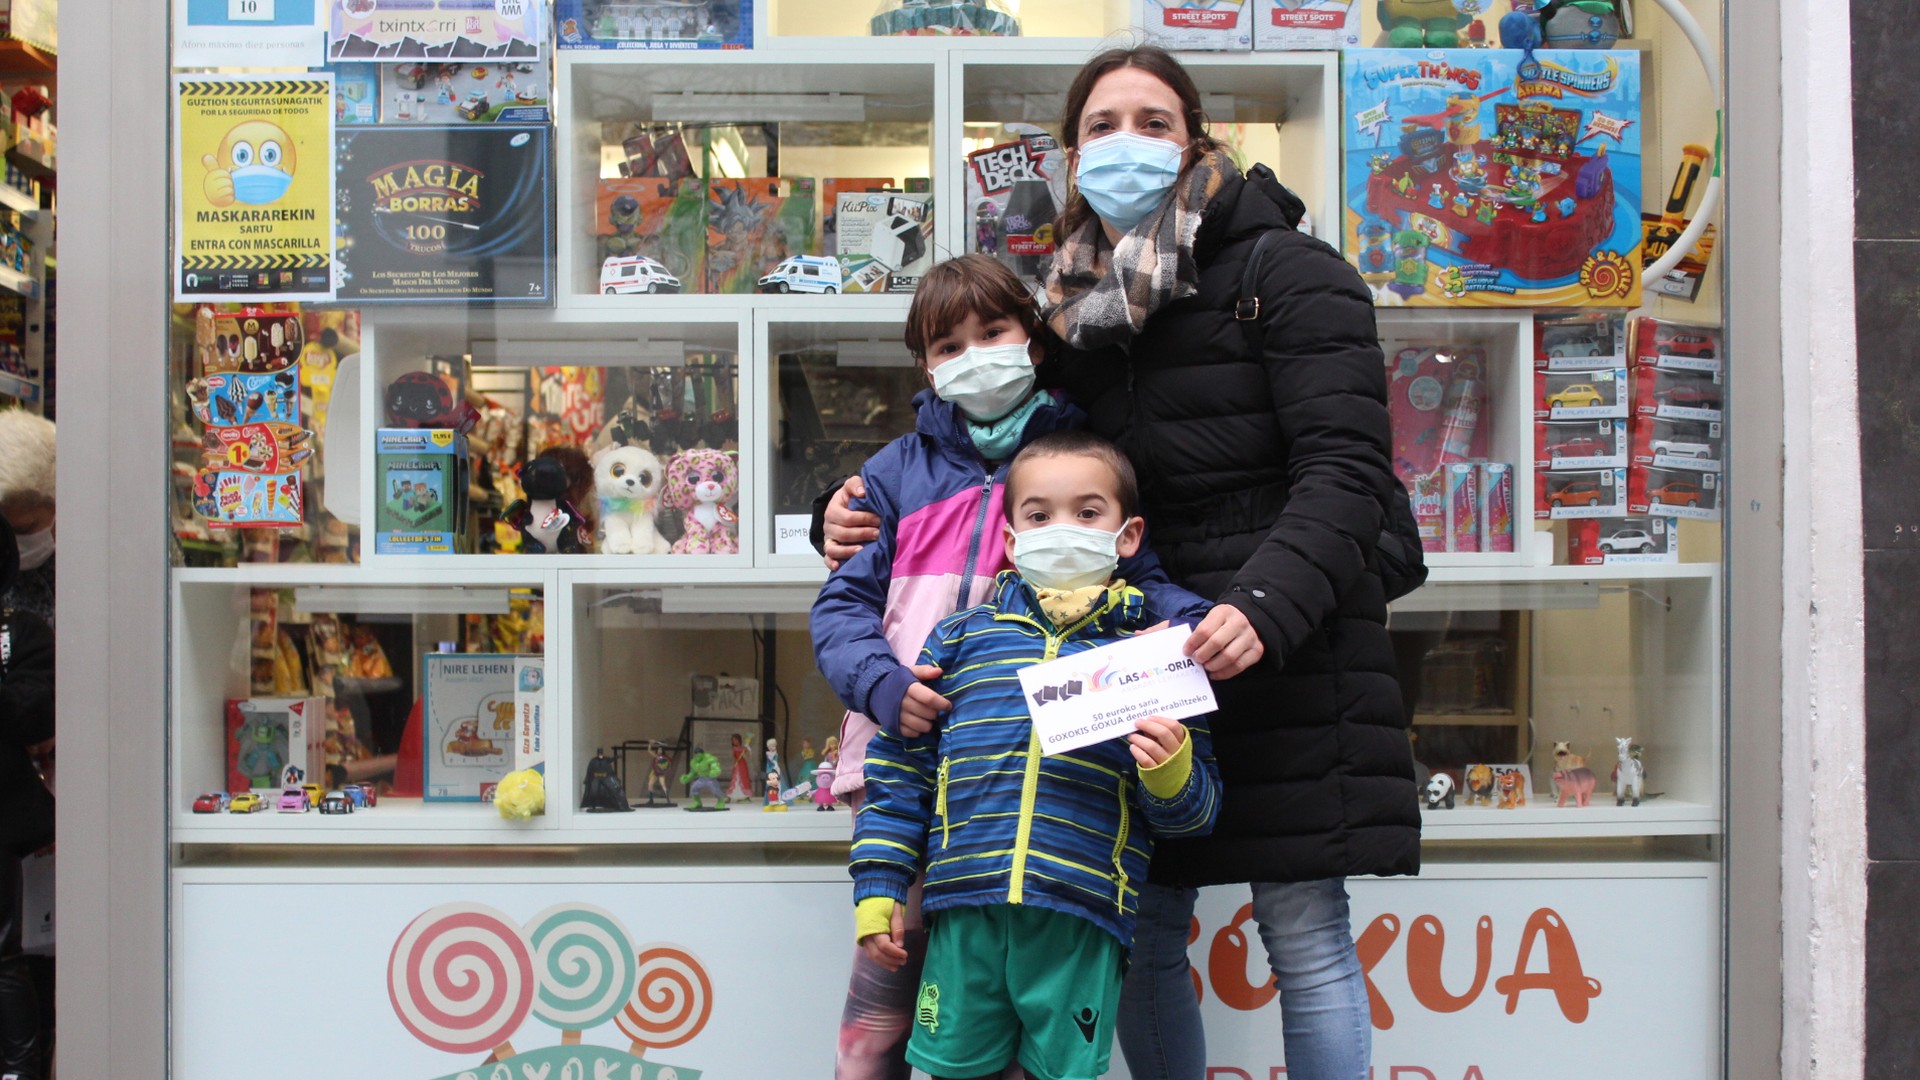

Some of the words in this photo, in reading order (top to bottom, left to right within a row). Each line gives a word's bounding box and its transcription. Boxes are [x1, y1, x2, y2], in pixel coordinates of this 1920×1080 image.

[241, 1, 257, 13] 10
[181, 40, 206, 49] Aforo
[208, 40, 243, 49] máximo
[245, 40, 264, 49] diez
[266, 42, 305, 50] personas
[1560, 71, 1612, 92] SPINNERS
[1517, 83, 1562, 99] ARENA
[187, 98, 229, 107] GUZTION
[230, 97, 323, 106] SEGURTASUNAGATIK
[228, 108, 272, 116] SEGURIDAD
[283, 107, 309, 115] TODOS
[974, 145, 1029, 176] TECH
[985, 160, 1039, 191] DECK
[371, 165, 480, 200] MAGIA
[390, 197, 469, 212] BORRAS
[196, 209, 315, 222] MASKARAREKIN
[239, 225, 273, 234] SARTU
[406, 225, 446, 240] 100
[191, 239, 226, 250] ENTRA
[228, 239, 251, 250] CON
[253, 238, 321, 249] MASCARILLA
[1448, 266, 1460, 280] 2
[1580, 256, 1596, 284] SPIN
[528, 282, 541, 292] 7+
[382, 435, 428, 444] MINECRAFT
[387, 461, 442, 471] MINECRAFT
[1419, 504, 1438, 514] POP
[443, 664, 469, 675] NIRE
[472, 664, 508, 674] LEHEN
[1092, 712, 1104, 722] 50
[1105, 704, 1137, 720] euroko
[1138, 697, 1160, 710] saria
[1048, 726, 1090, 744] GOXOKIS
[1091, 716, 1124, 732] GOXUA
[1126, 706, 1159, 721] dendan
[1160, 694, 1208, 713] erabiltzeko
